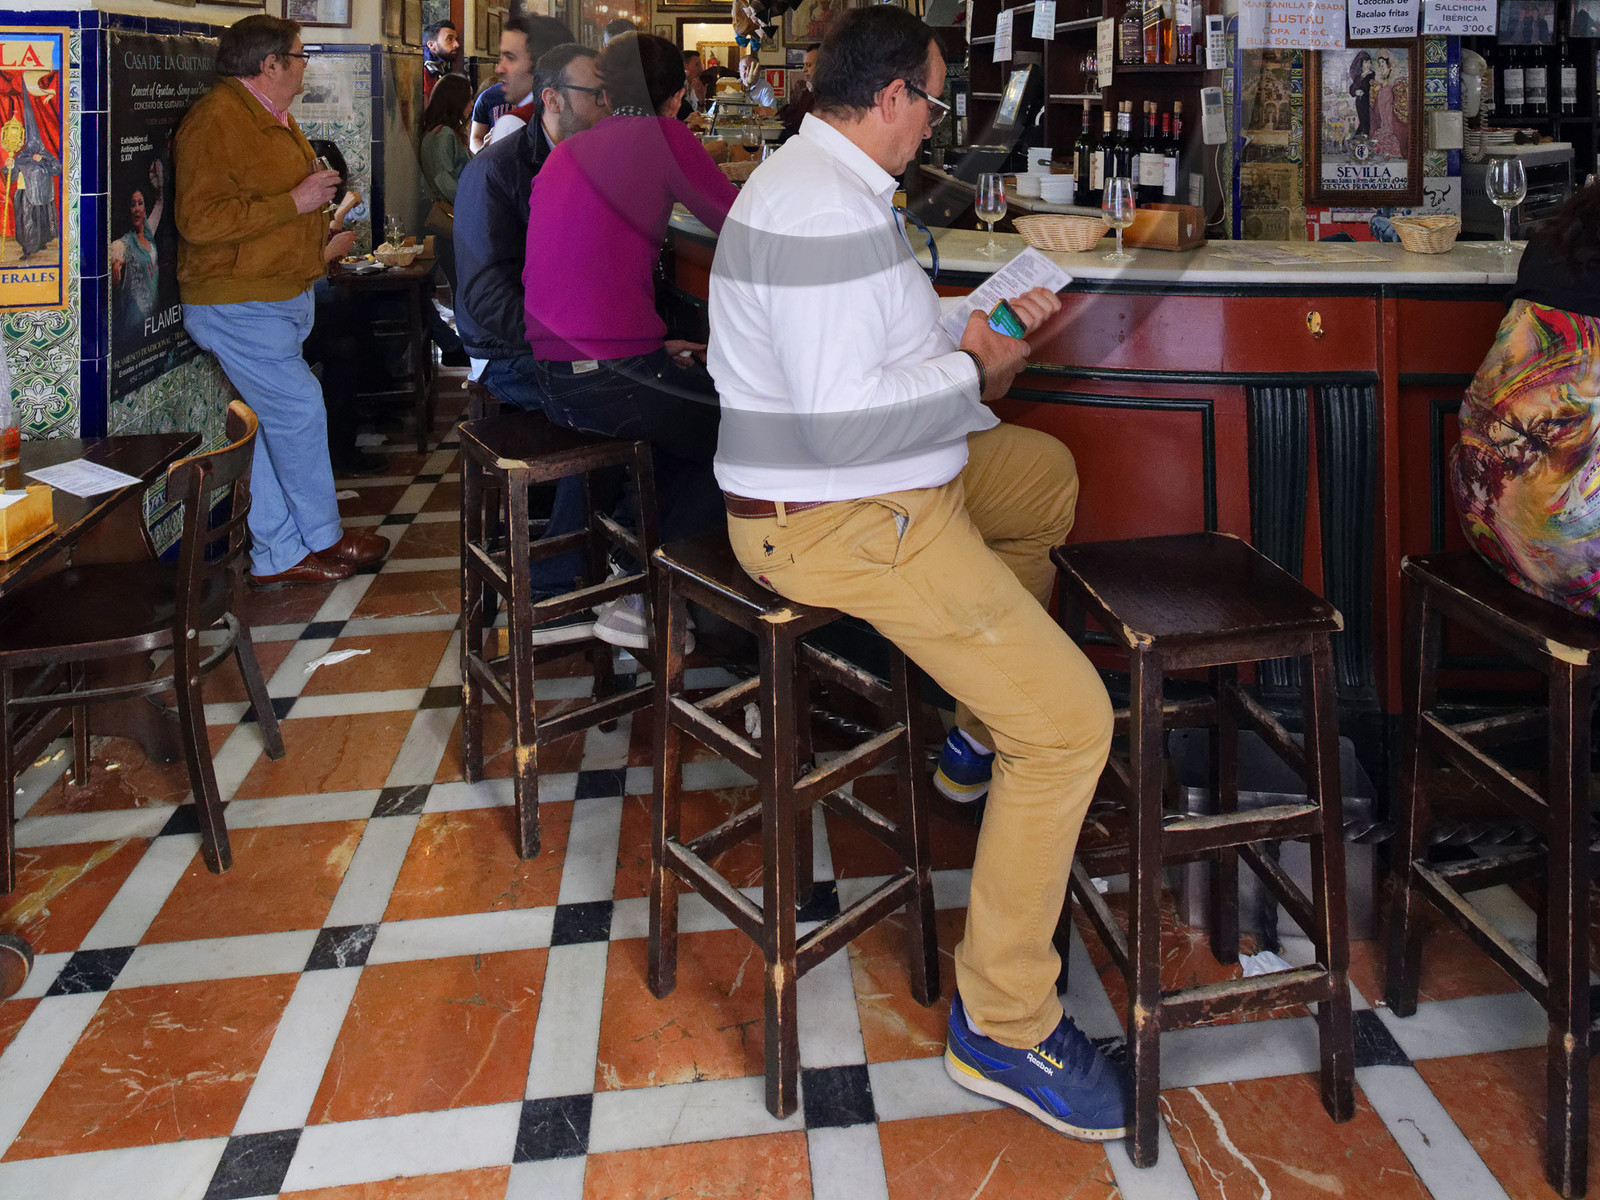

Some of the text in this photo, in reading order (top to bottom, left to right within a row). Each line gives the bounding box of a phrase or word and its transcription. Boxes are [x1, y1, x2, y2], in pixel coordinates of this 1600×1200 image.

[1242, 1, 1345, 11] MANZANILLA PASADA
[1434, 3, 1487, 11] SALCHICHA
[1268, 12, 1324, 24] LUSTAU
[1355, 8, 1409, 19] Bacalao fritas
[1442, 14, 1478, 22] IBÉRICA
[1262, 27, 1290, 35] COPA
[1351, 26, 1371, 36] Tapa
[1426, 24, 1451, 32] TAPA
[124, 51, 148, 70] CASA
[149, 54, 160, 70] DE
[164, 56, 176, 71] LA
[131, 83, 150, 97] Concert
[1337, 166, 1392, 178] SEVILLA
[1, 271, 56, 284] ERALES
[1026, 1052, 1054, 1077] Reebok
